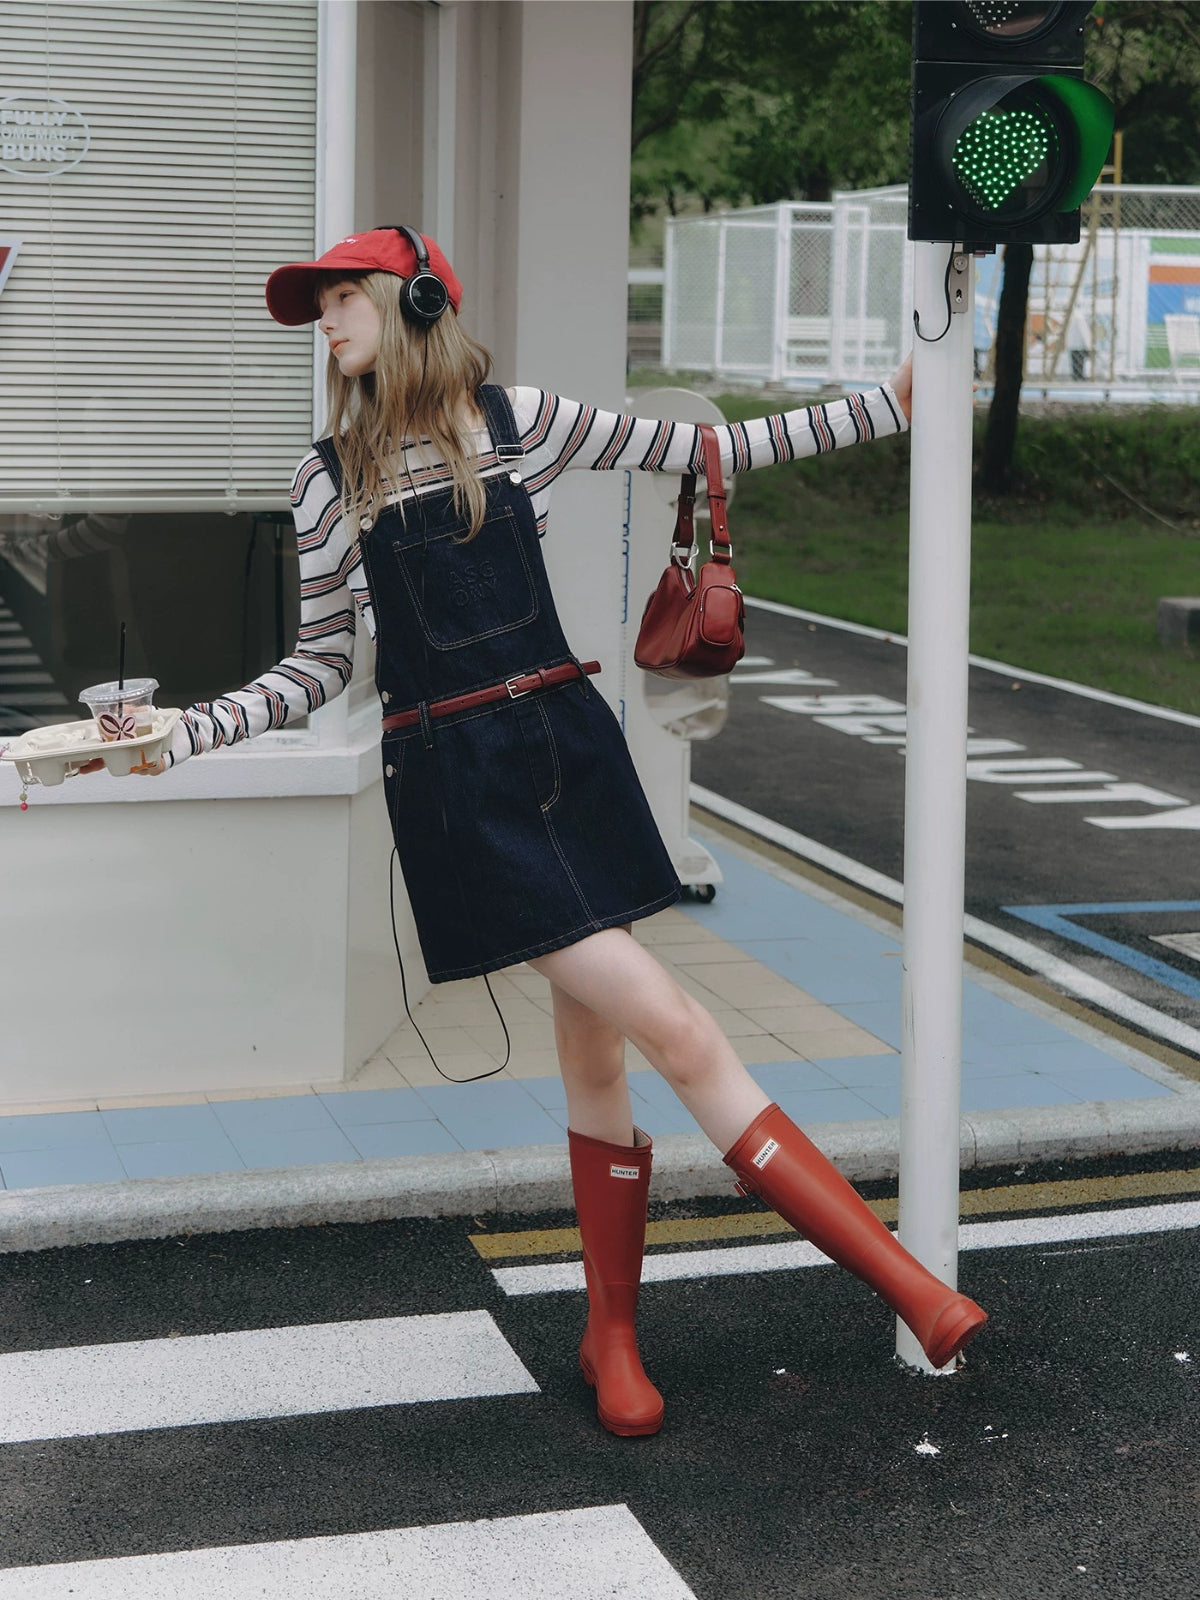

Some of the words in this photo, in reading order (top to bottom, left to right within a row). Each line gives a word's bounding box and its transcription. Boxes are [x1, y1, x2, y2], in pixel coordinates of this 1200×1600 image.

[0, 110, 67, 126] FULLY
[0, 128, 80, 141] OMEMADE
[2, 143, 67, 161] BUNS
[755, 1141, 776, 1166] HUNTER
[611, 1168, 638, 1176] HUNTER
